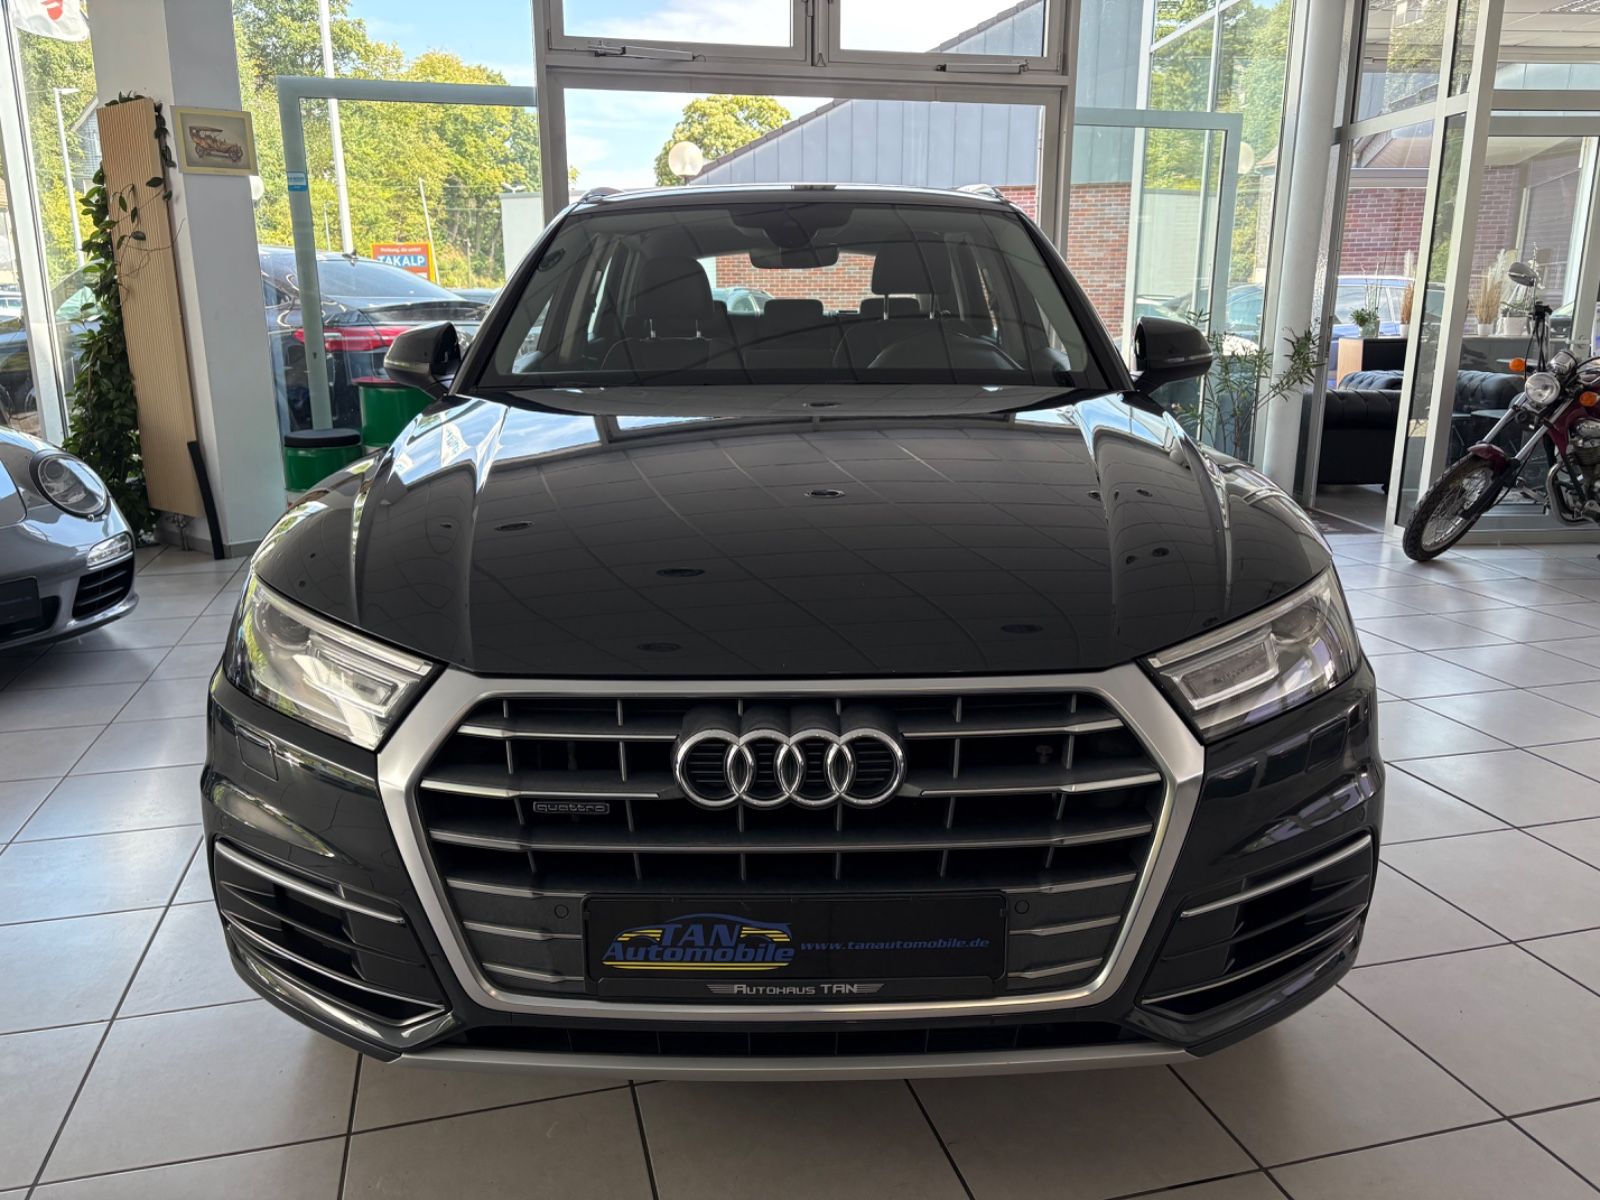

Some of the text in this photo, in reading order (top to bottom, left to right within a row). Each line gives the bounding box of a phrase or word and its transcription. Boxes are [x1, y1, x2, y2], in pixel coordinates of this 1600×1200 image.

[537, 804, 606, 813] quattro
[661, 924, 740, 946] TAN
[800, 938, 990, 950] www.tanautomobile.de
[602, 941, 795, 962] Automobile
[820, 983, 858, 994] TAN
